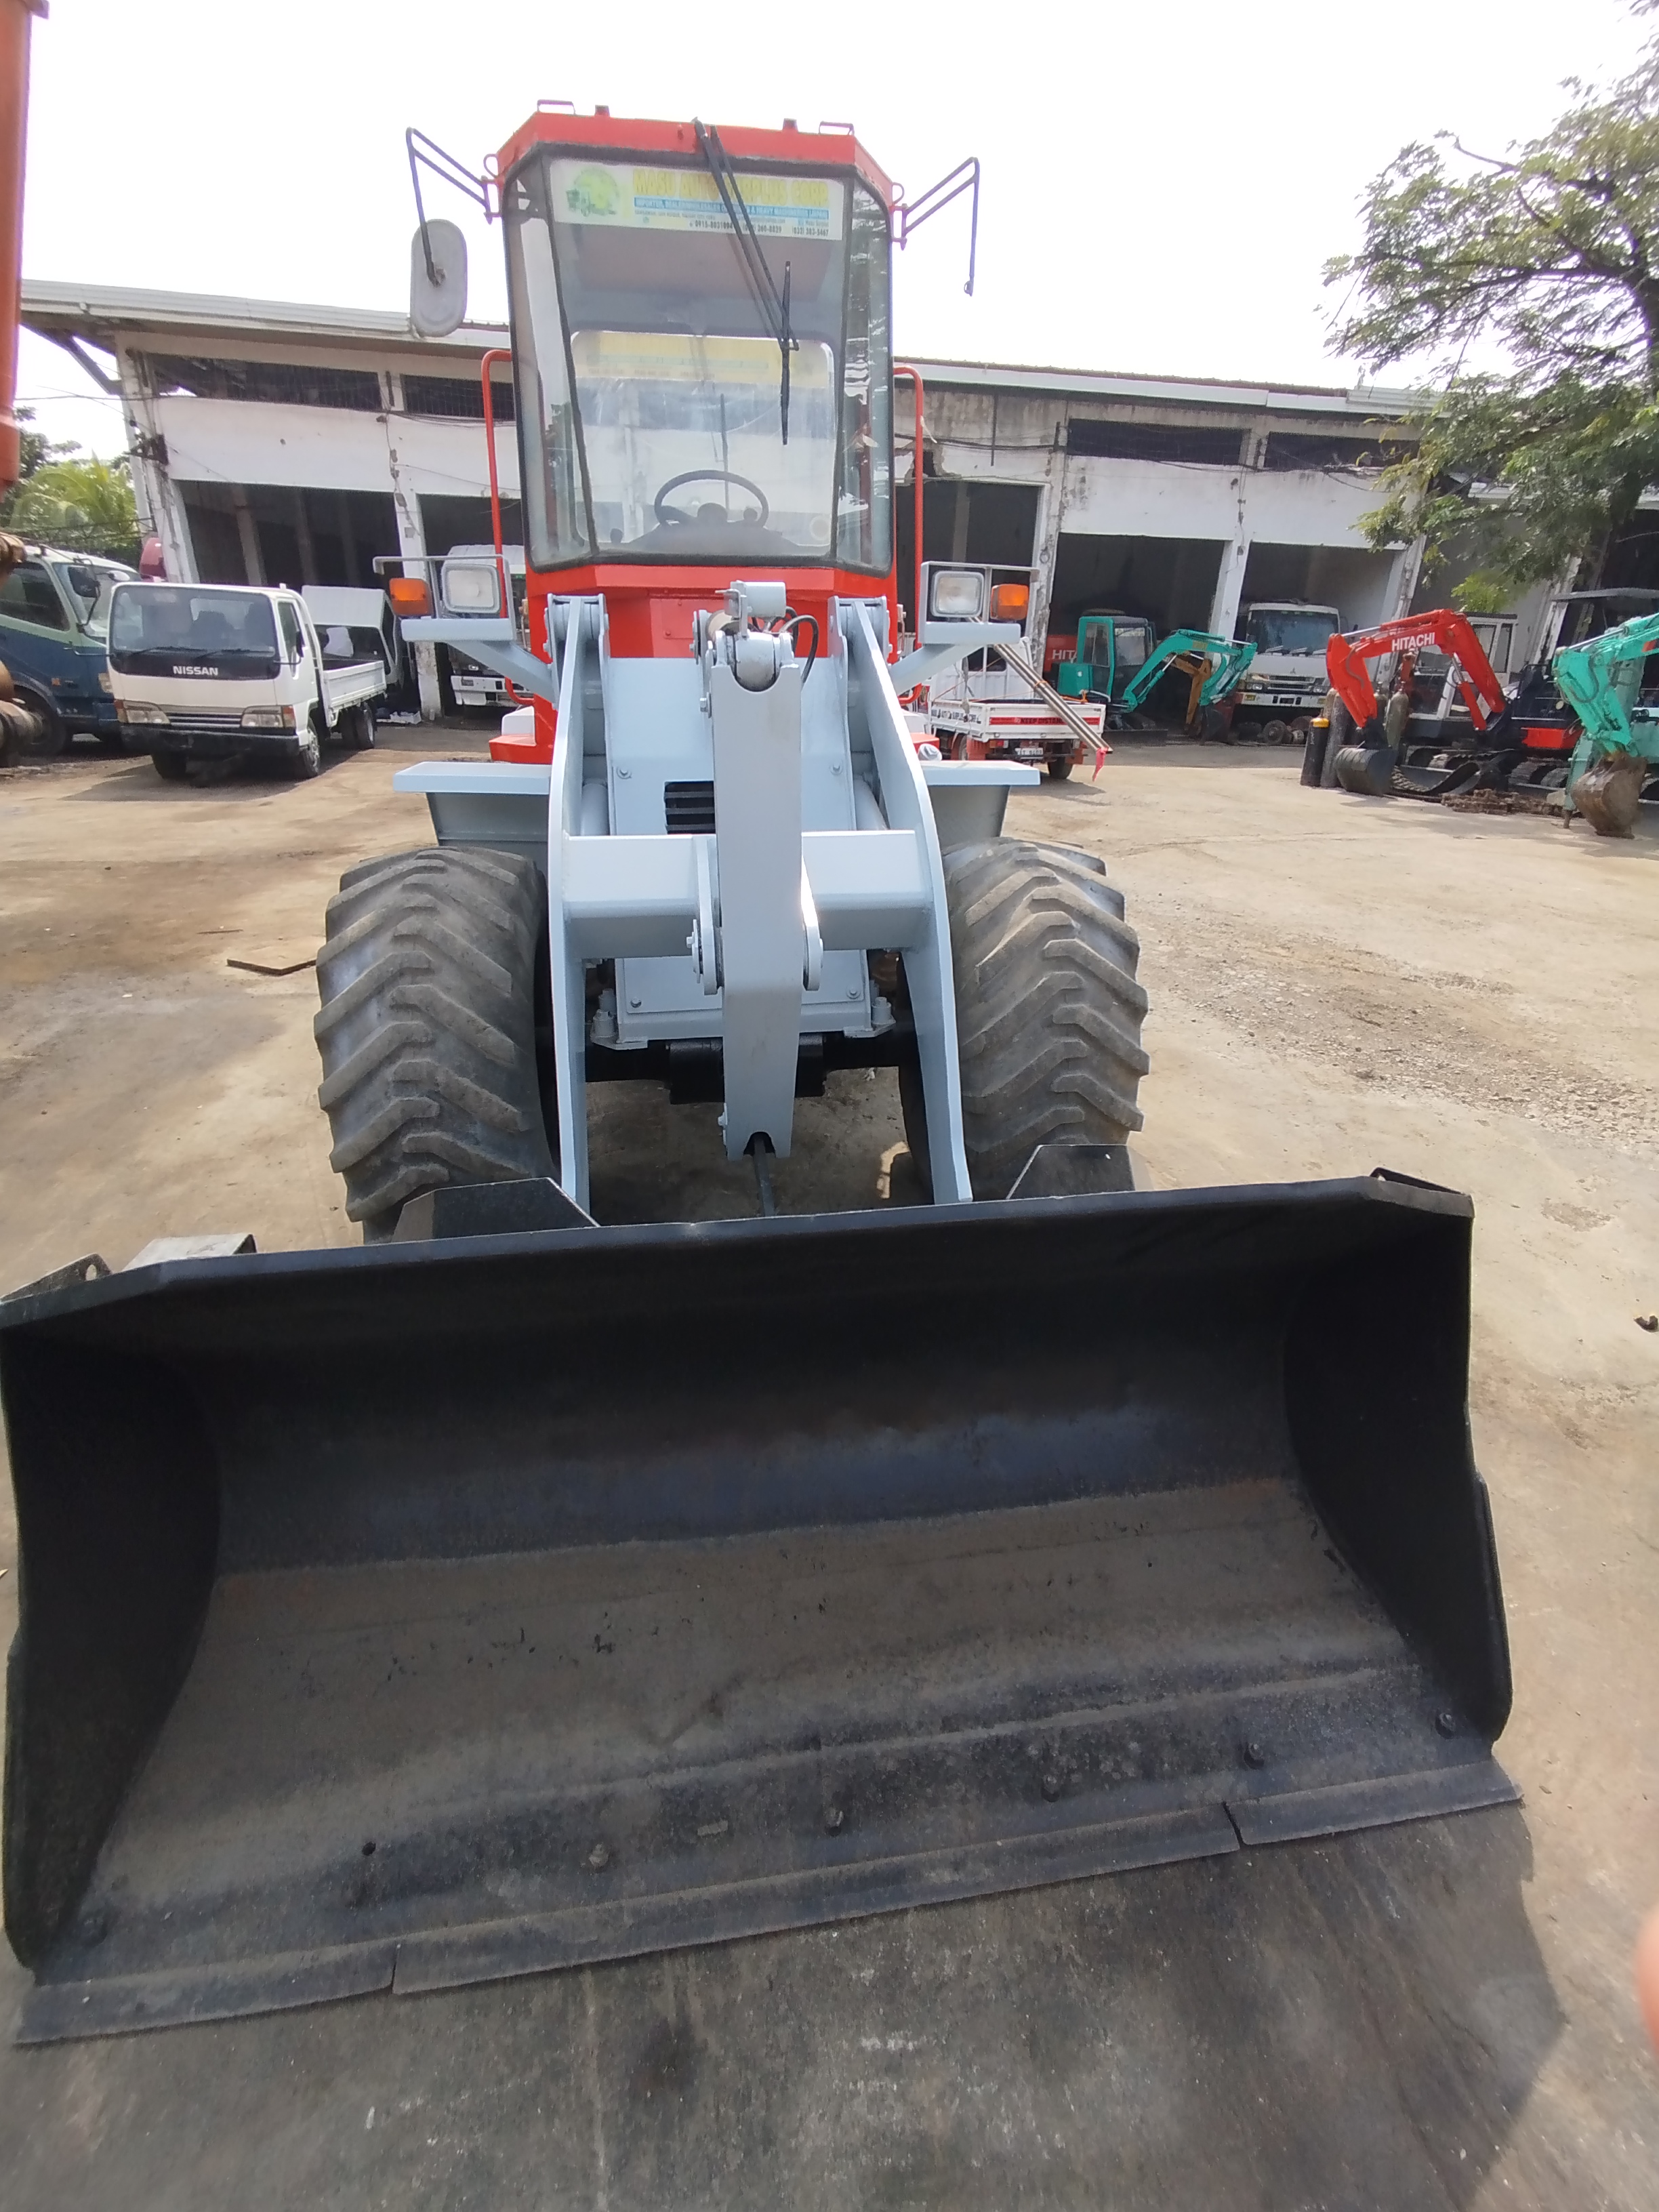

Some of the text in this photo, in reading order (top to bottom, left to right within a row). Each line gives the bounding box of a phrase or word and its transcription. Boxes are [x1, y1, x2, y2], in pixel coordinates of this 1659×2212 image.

[633, 169, 675, 196] MASU
[1391, 632, 1435, 651] HITACHI
[173, 665, 218, 676] NISSAN
